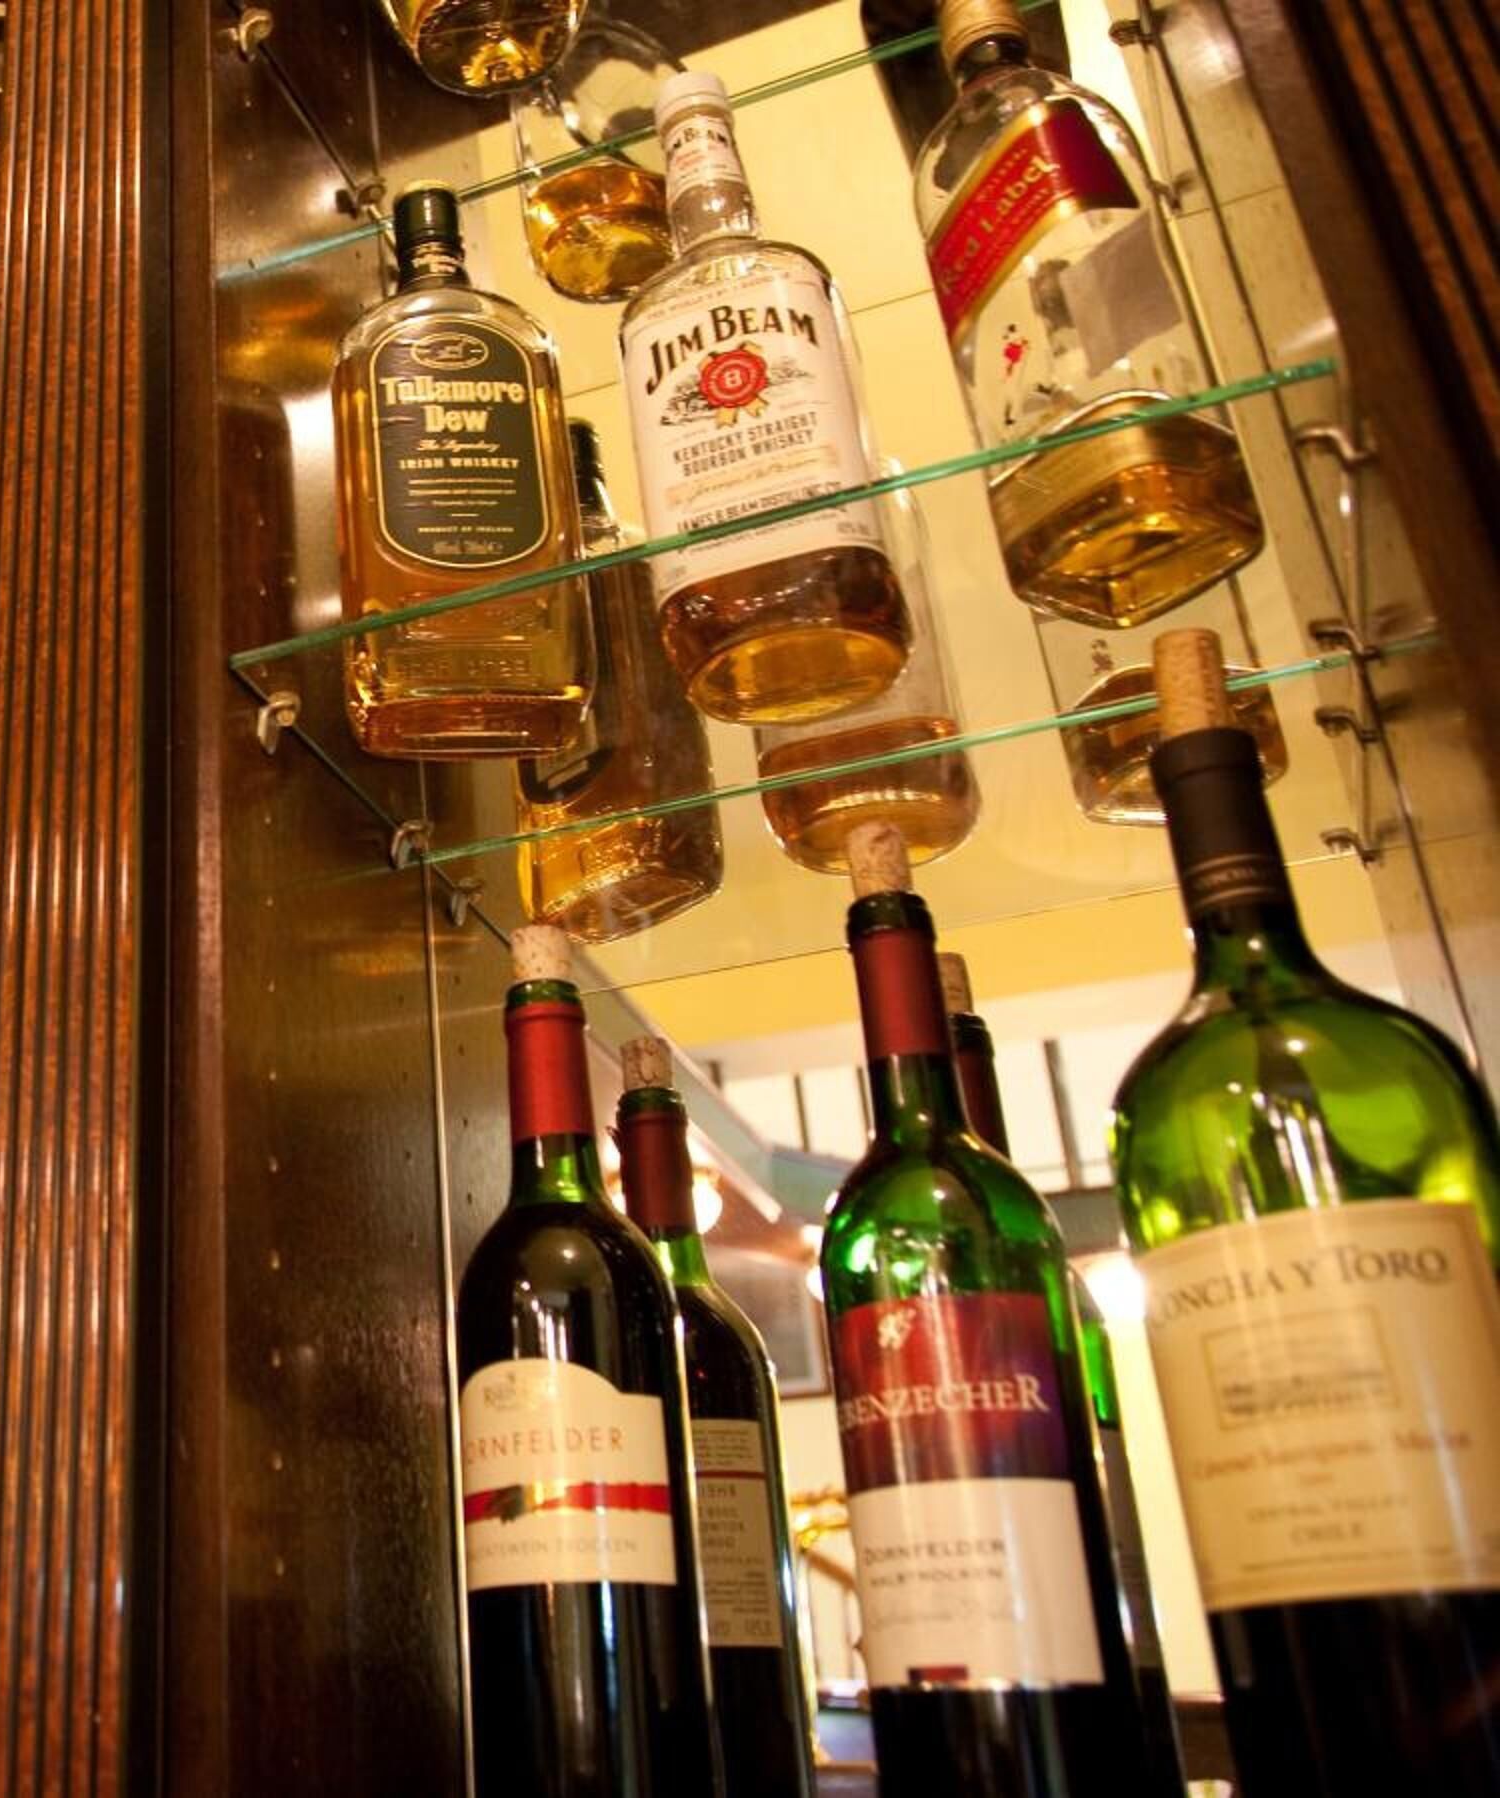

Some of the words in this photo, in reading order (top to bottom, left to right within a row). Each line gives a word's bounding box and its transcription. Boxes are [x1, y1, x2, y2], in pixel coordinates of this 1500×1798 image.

[645, 323, 704, 395] JIM
[708, 304, 820, 347] BEAM
[379, 375, 526, 405] Tullamore
[423, 404, 490, 433] Dew
[673, 431, 743, 464] KENTUCKY
[747, 411, 818, 442] STRAIGHT
[398, 457, 445, 470] IRISH
[449, 456, 520, 469] WHISKEY
[682, 447, 747, 477] BOURBON
[751, 430, 814, 457] WHISKEY
[1289, 1259, 1317, 1289] Y
[1334, 1244, 1452, 1288] TORO
